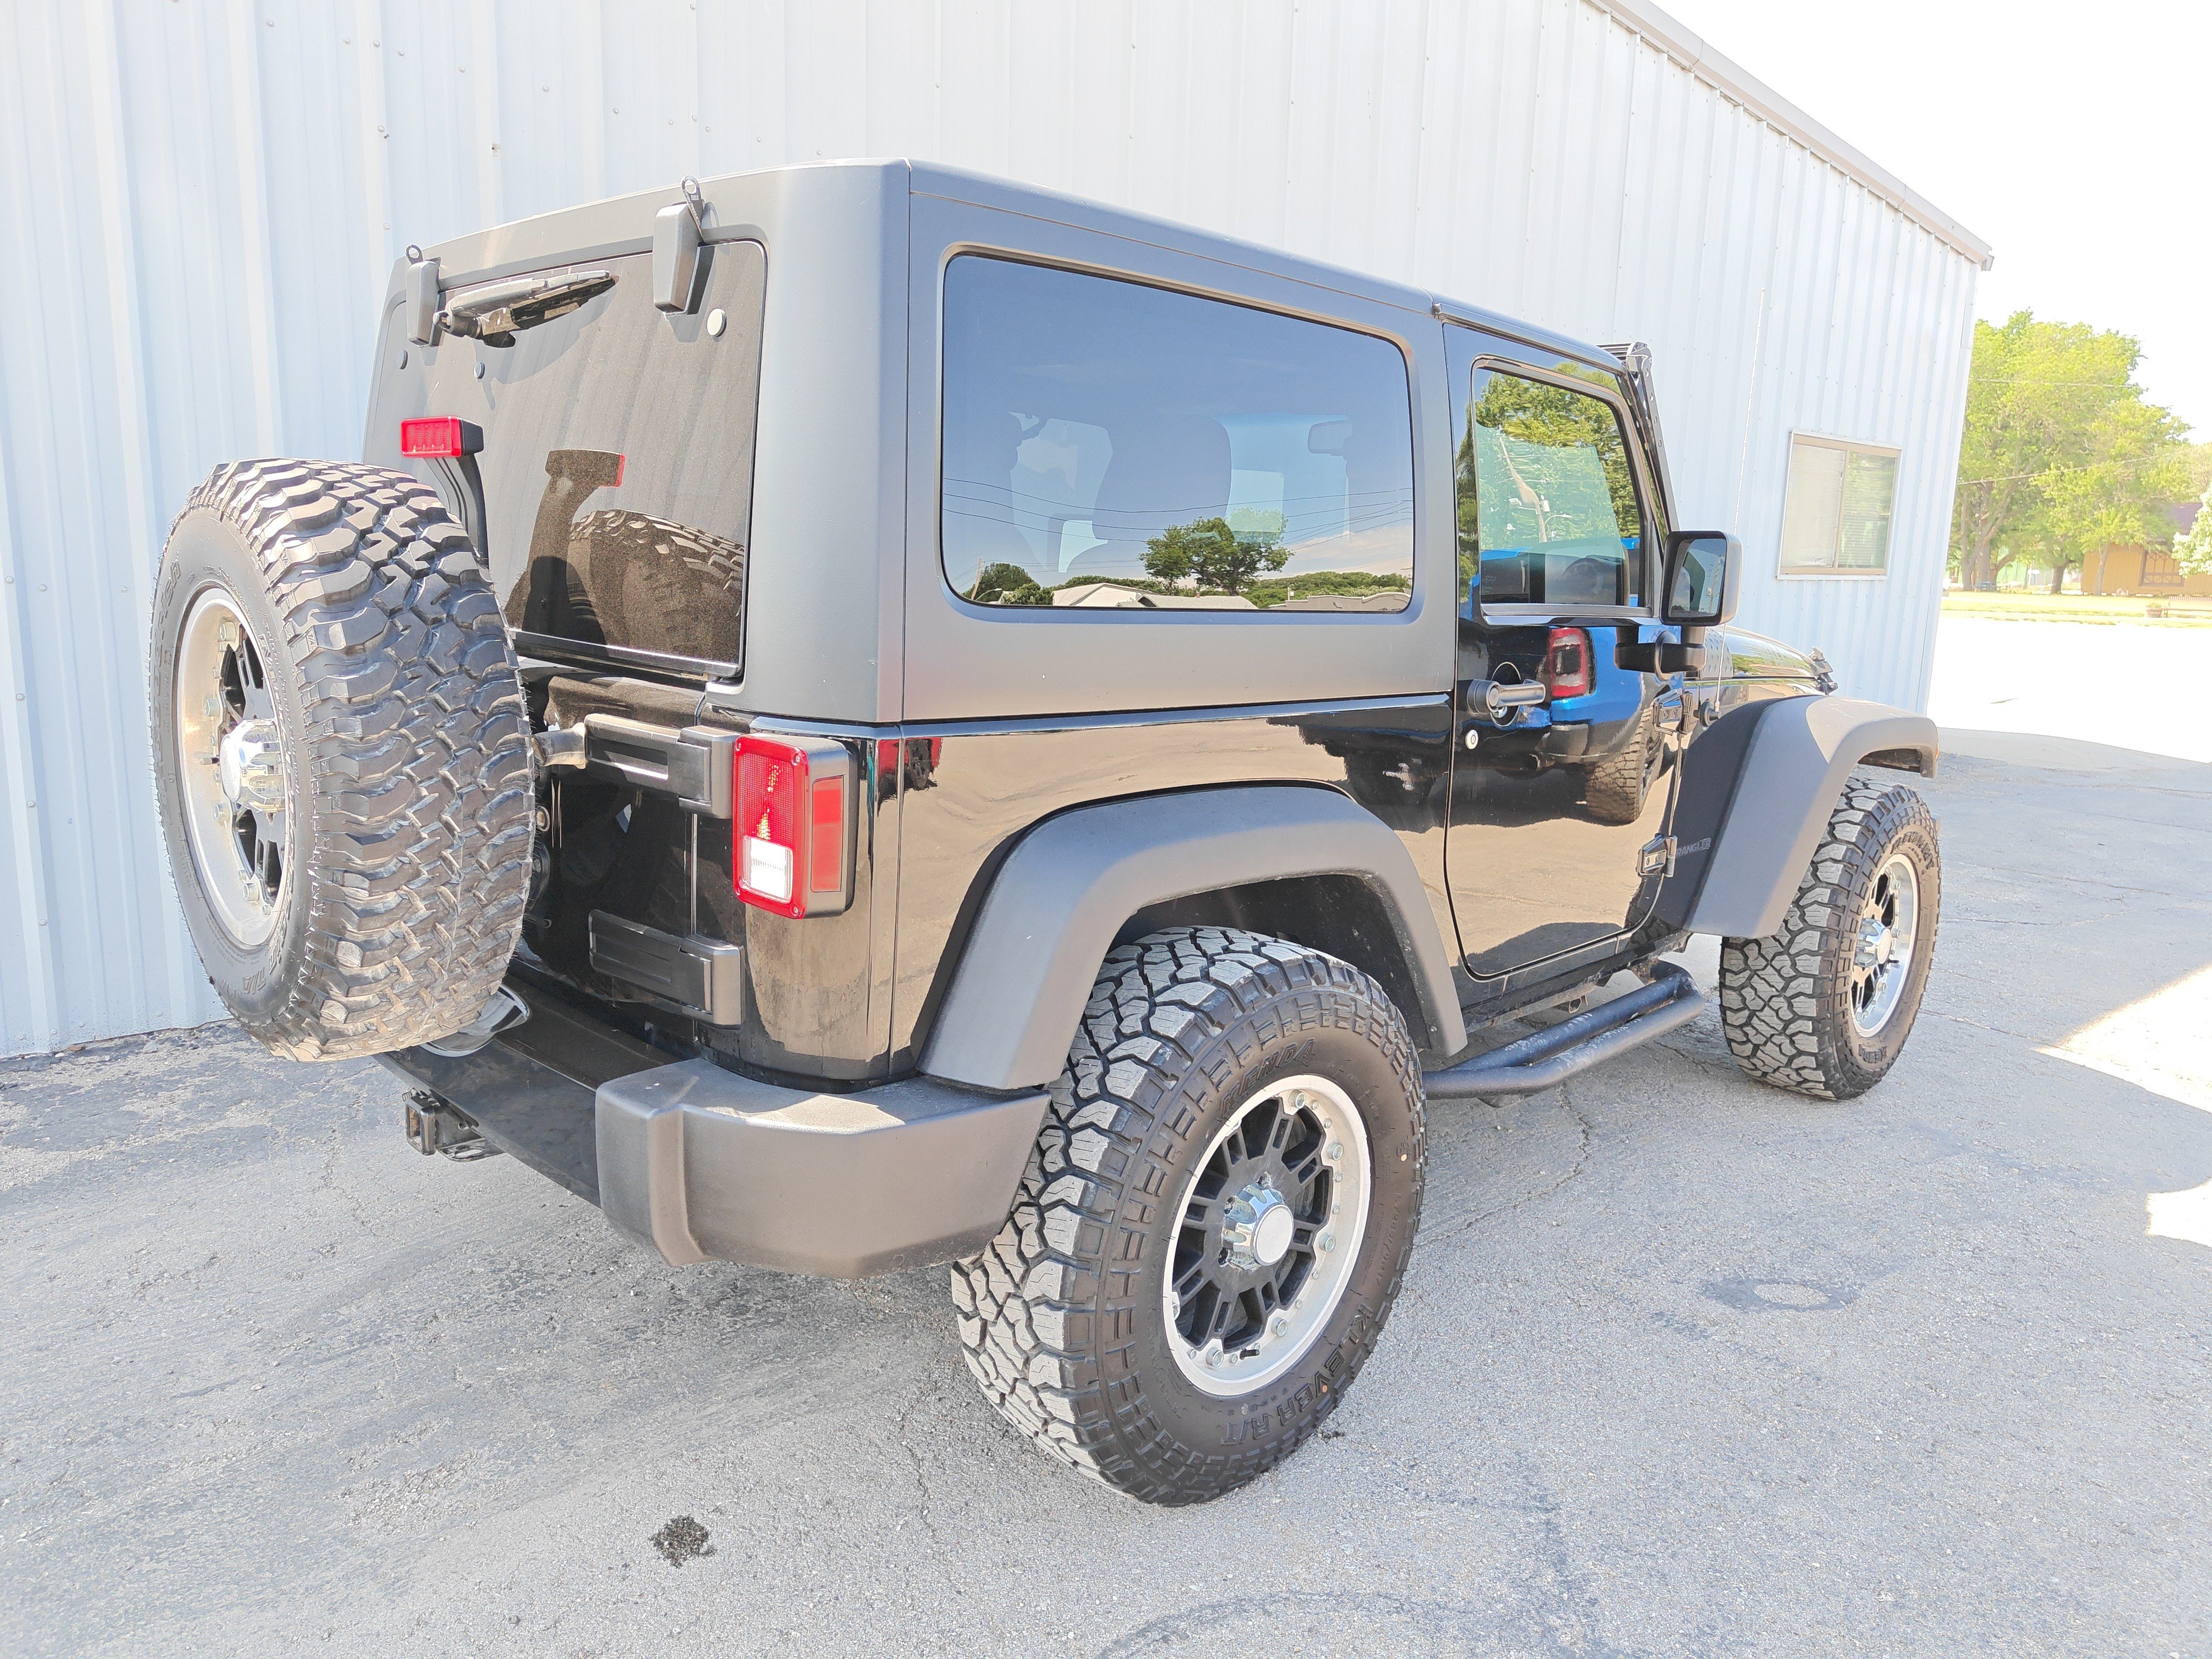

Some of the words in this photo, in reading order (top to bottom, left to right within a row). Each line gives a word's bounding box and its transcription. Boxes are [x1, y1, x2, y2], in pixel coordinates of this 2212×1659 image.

[1676, 837, 1712, 859] RANGLER
[1220, 1037, 1316, 1118] KENDA
[1276, 1303, 1374, 1426] KLEVER
[1220, 1412, 1270, 1447] R/T
